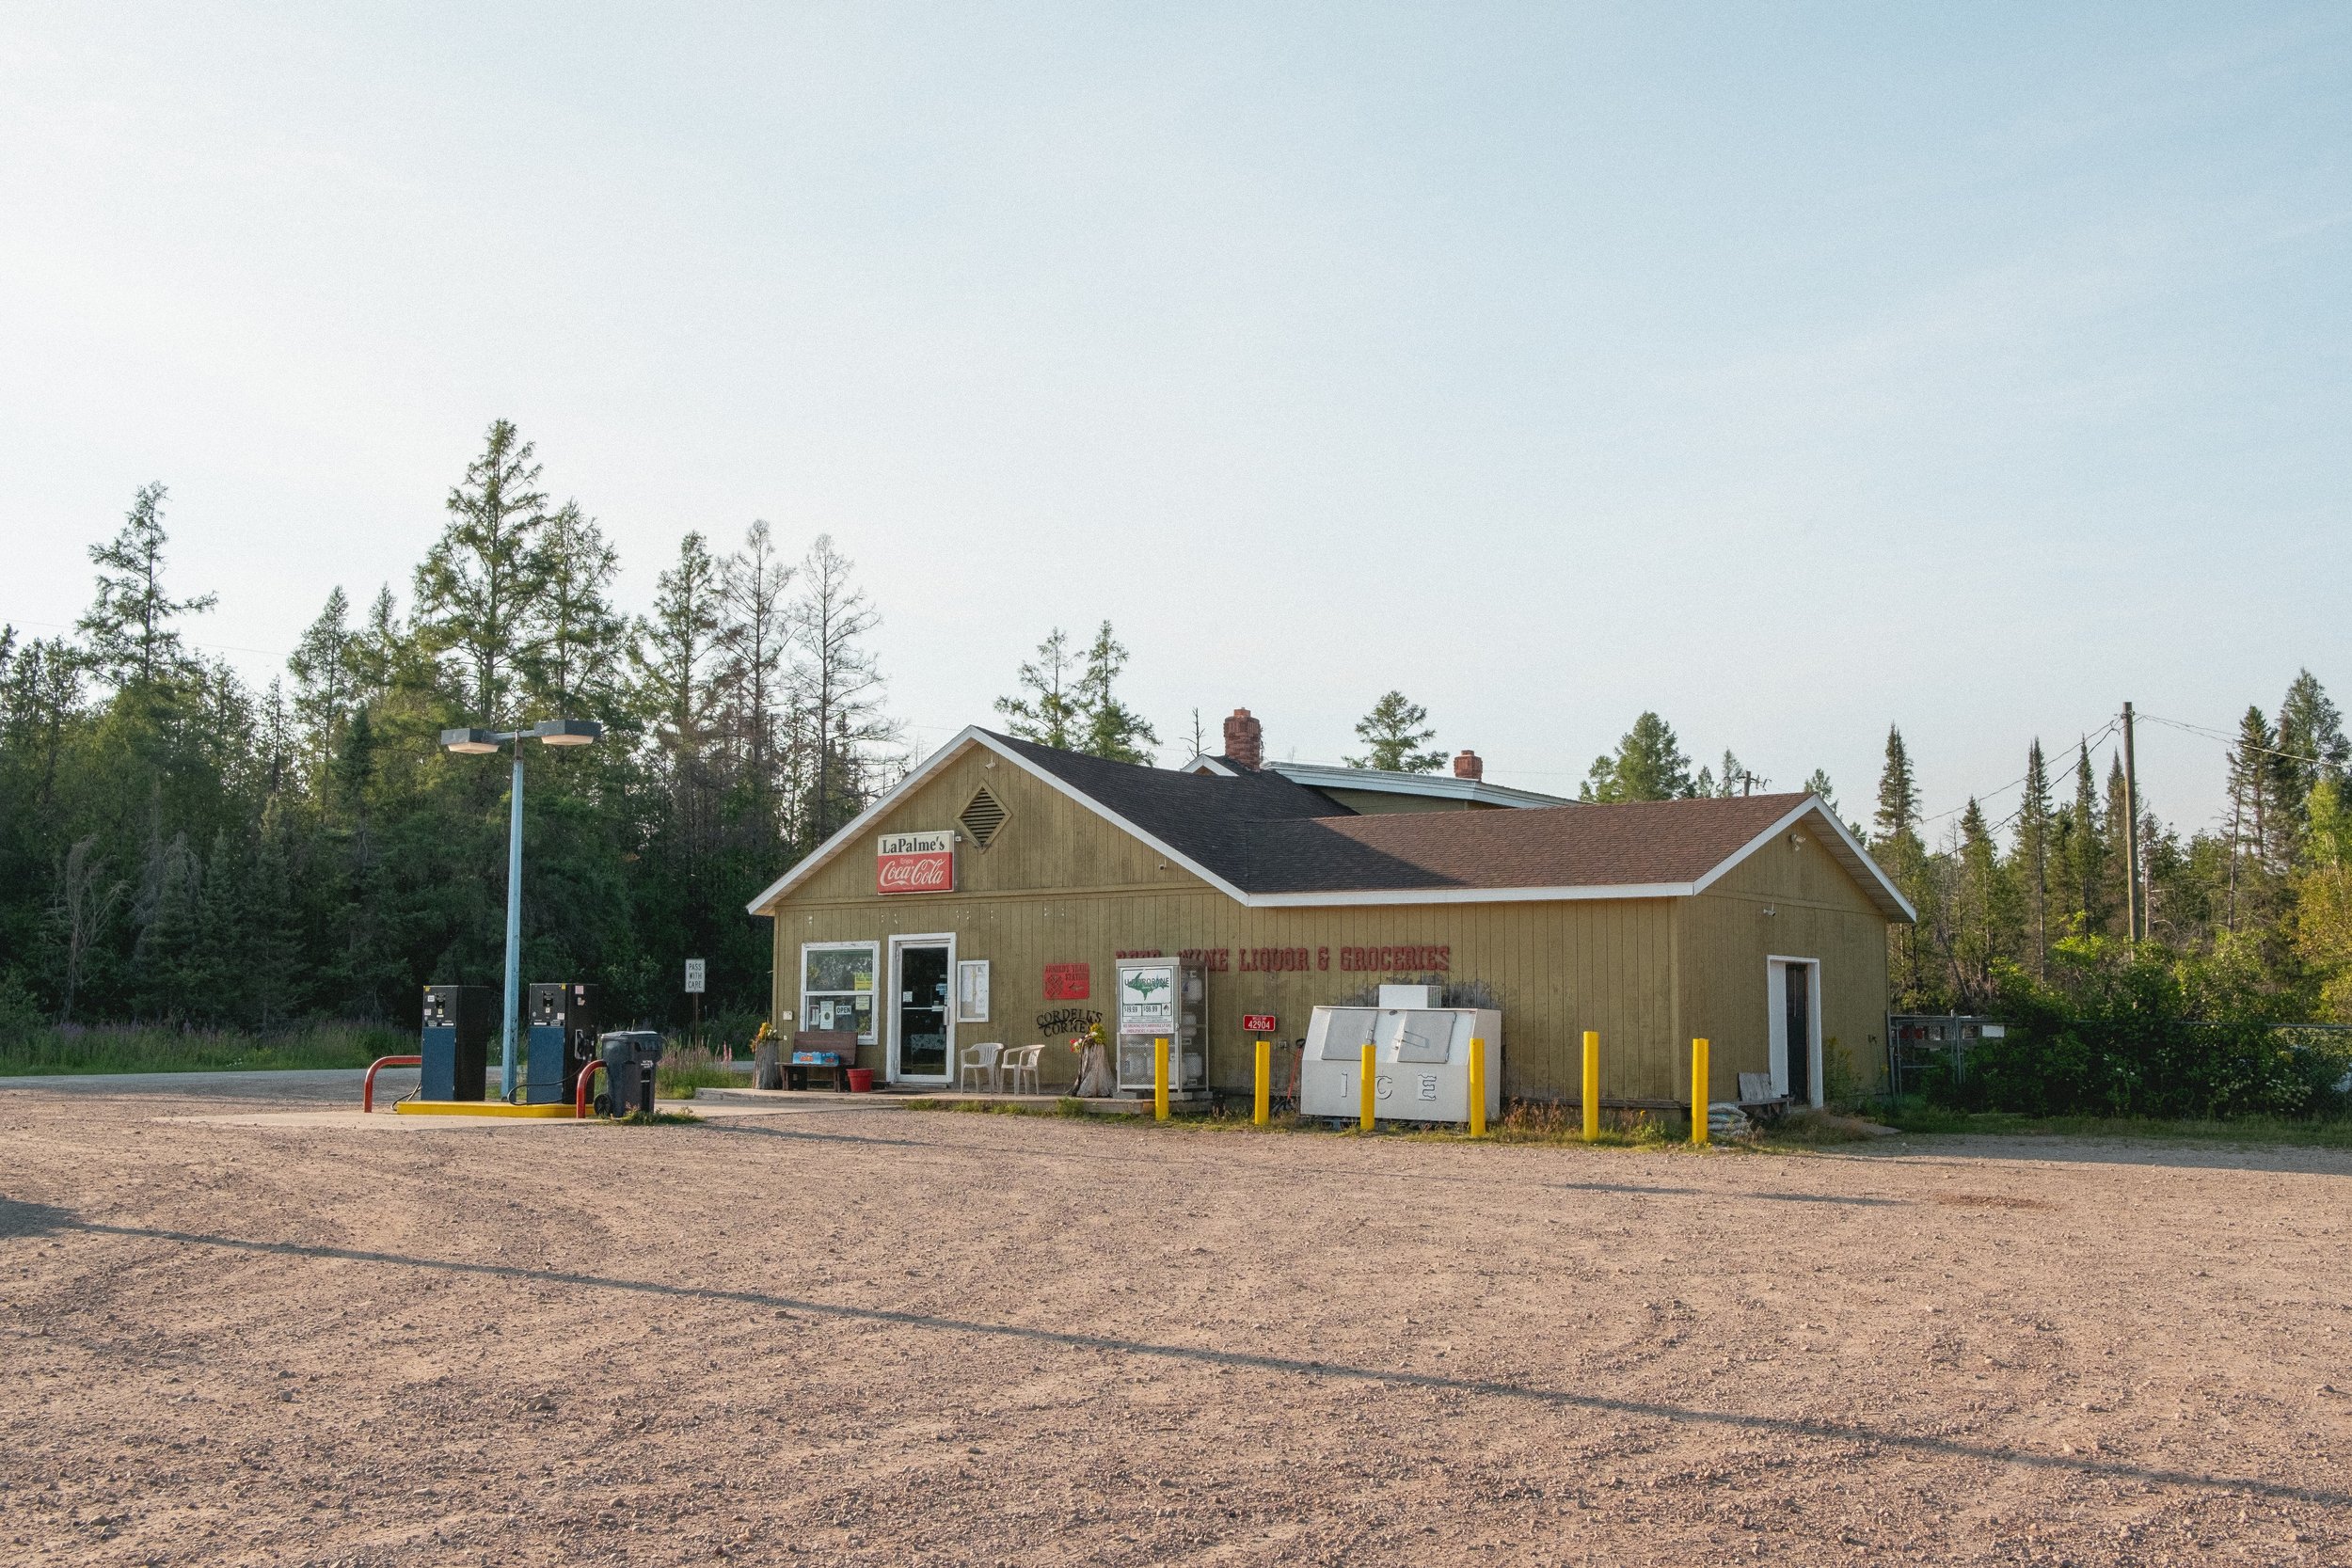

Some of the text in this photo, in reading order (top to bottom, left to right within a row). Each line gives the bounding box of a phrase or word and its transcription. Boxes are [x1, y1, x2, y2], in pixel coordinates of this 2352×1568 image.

[882, 836, 945, 854] LaPalme's
[1239, 947, 1310, 972] LIQUOR
[1317, 946, 1329, 972] &
[1340, 945, 1450, 972] GROCERIES
[1037, 1009, 1103, 1026] CORDELL'S
[1248, 1020, 1270, 1030] 42904
[1043, 1020, 1092, 1037] CORNE
